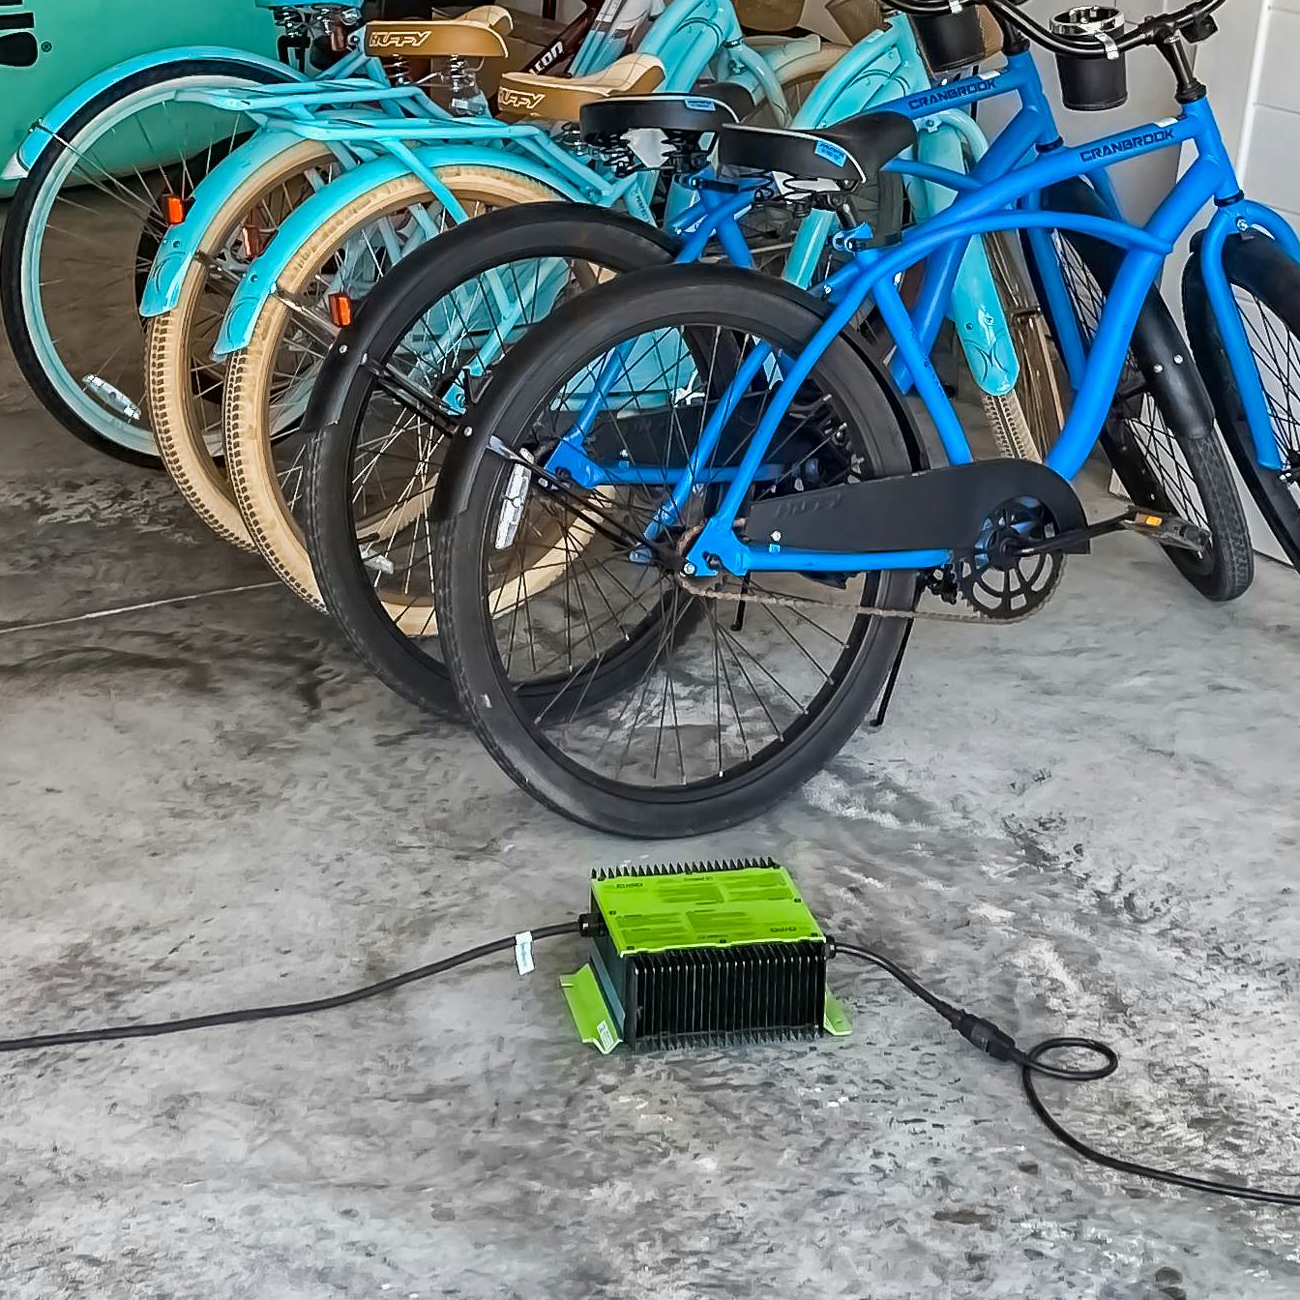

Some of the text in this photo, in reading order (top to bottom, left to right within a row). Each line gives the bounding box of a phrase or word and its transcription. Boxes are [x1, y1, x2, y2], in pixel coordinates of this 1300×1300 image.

[369, 31, 431, 47] HUFFY
[907, 79, 997, 110] CRANBROOK
[1079, 128, 1173, 162] CRANBROOK
